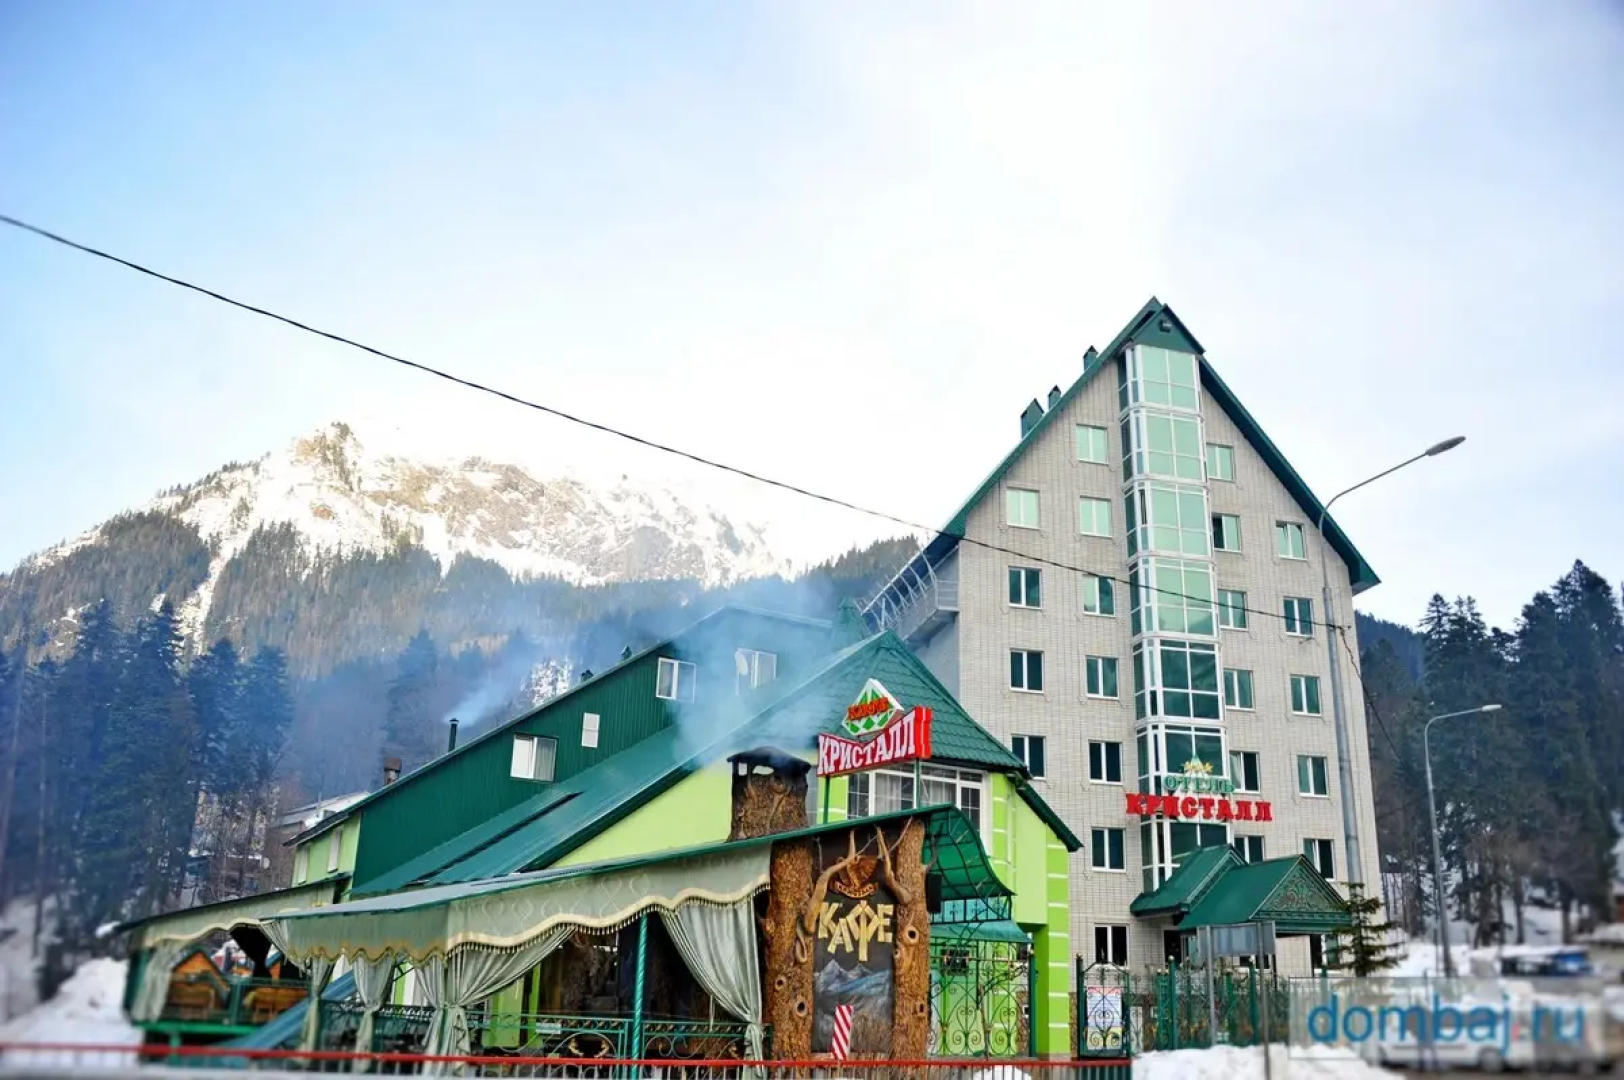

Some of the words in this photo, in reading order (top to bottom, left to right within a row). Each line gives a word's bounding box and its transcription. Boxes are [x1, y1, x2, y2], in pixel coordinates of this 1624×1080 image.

[817, 709, 916, 775] КРИСТАЛЛ
[1126, 793, 1272, 821] КРИСТАЛЛ
[1164, 776, 1235, 793] ОТЕЛЬ
[818, 900, 894, 962] КАФЕ
